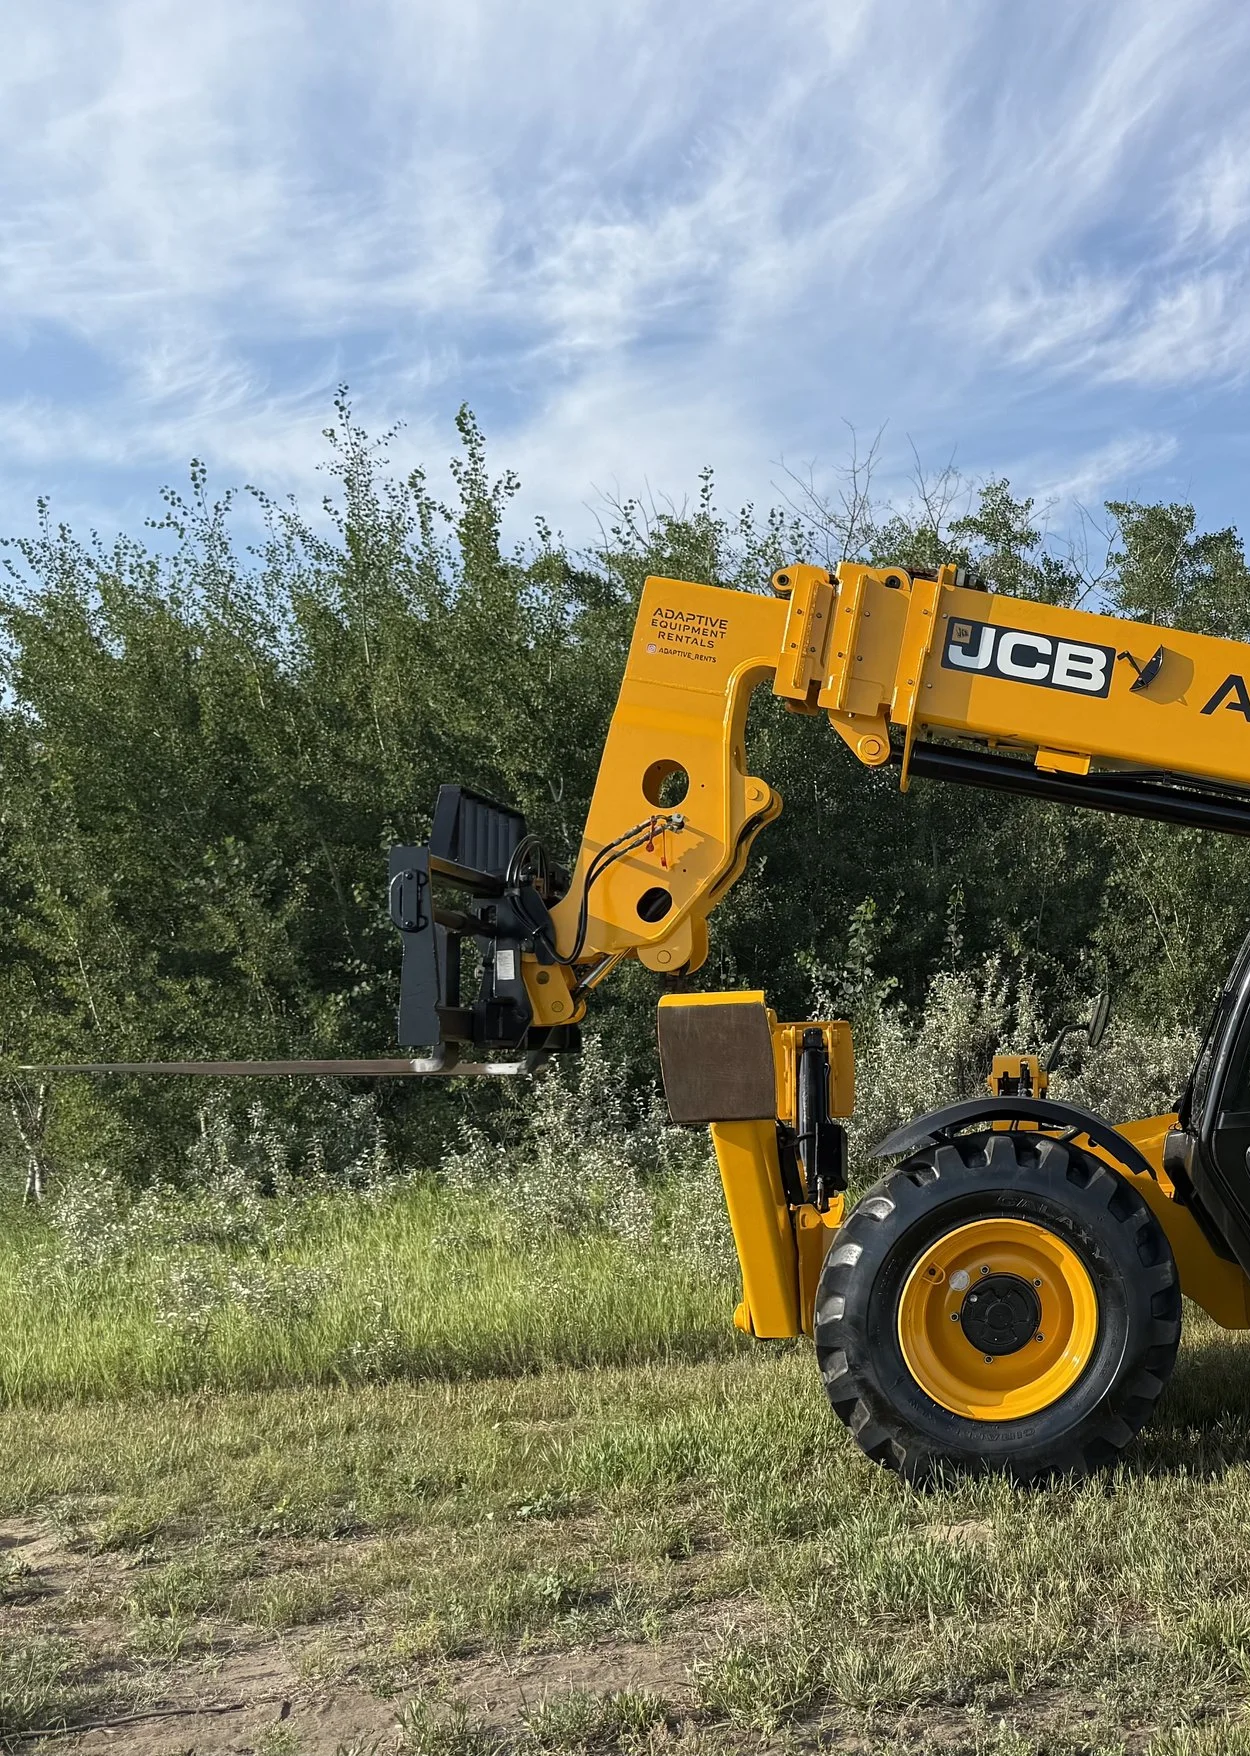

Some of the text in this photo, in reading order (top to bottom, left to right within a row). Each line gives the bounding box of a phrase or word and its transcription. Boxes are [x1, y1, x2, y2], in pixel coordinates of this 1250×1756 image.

[651, 618, 727, 639] EQUIPMENT
[653, 607, 729, 630] ADAPTIVE
[657, 631, 715, 649] RENTALS
[658, 647, 717, 663] ADAPTIVE_RENTS
[948, 626, 1107, 692] JCB
